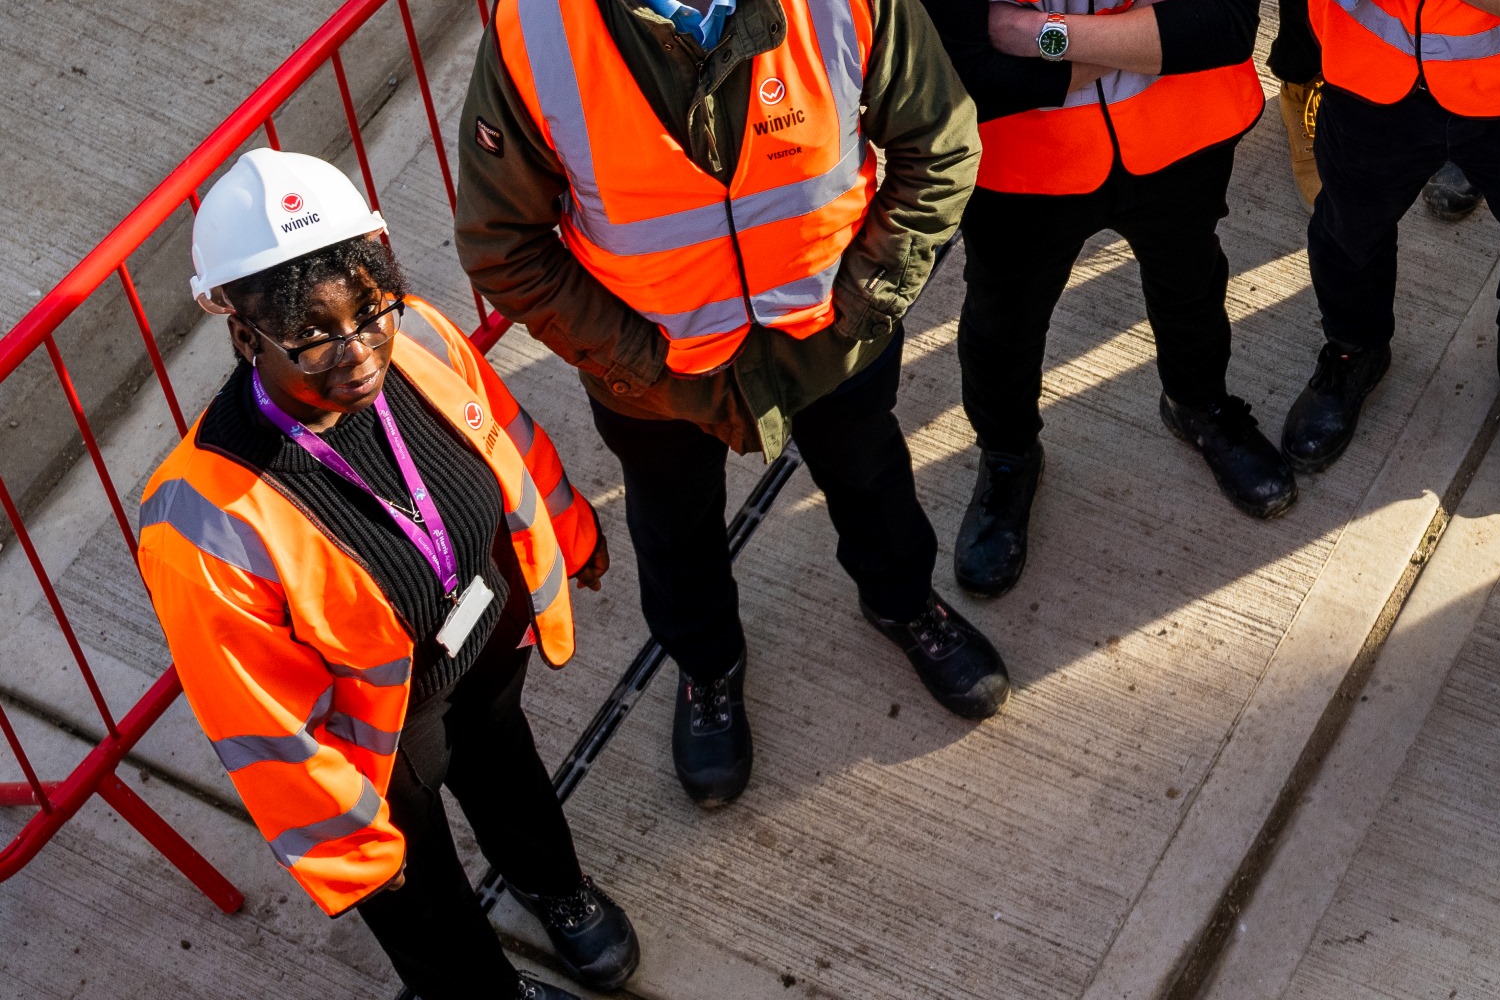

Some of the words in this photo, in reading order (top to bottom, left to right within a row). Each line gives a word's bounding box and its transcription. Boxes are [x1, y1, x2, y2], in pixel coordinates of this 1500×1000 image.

[753, 107, 806, 136] winvic
[767, 146, 803, 161] VISITOR
[280, 211, 320, 234] winvic
[485, 418, 501, 459] winvi
